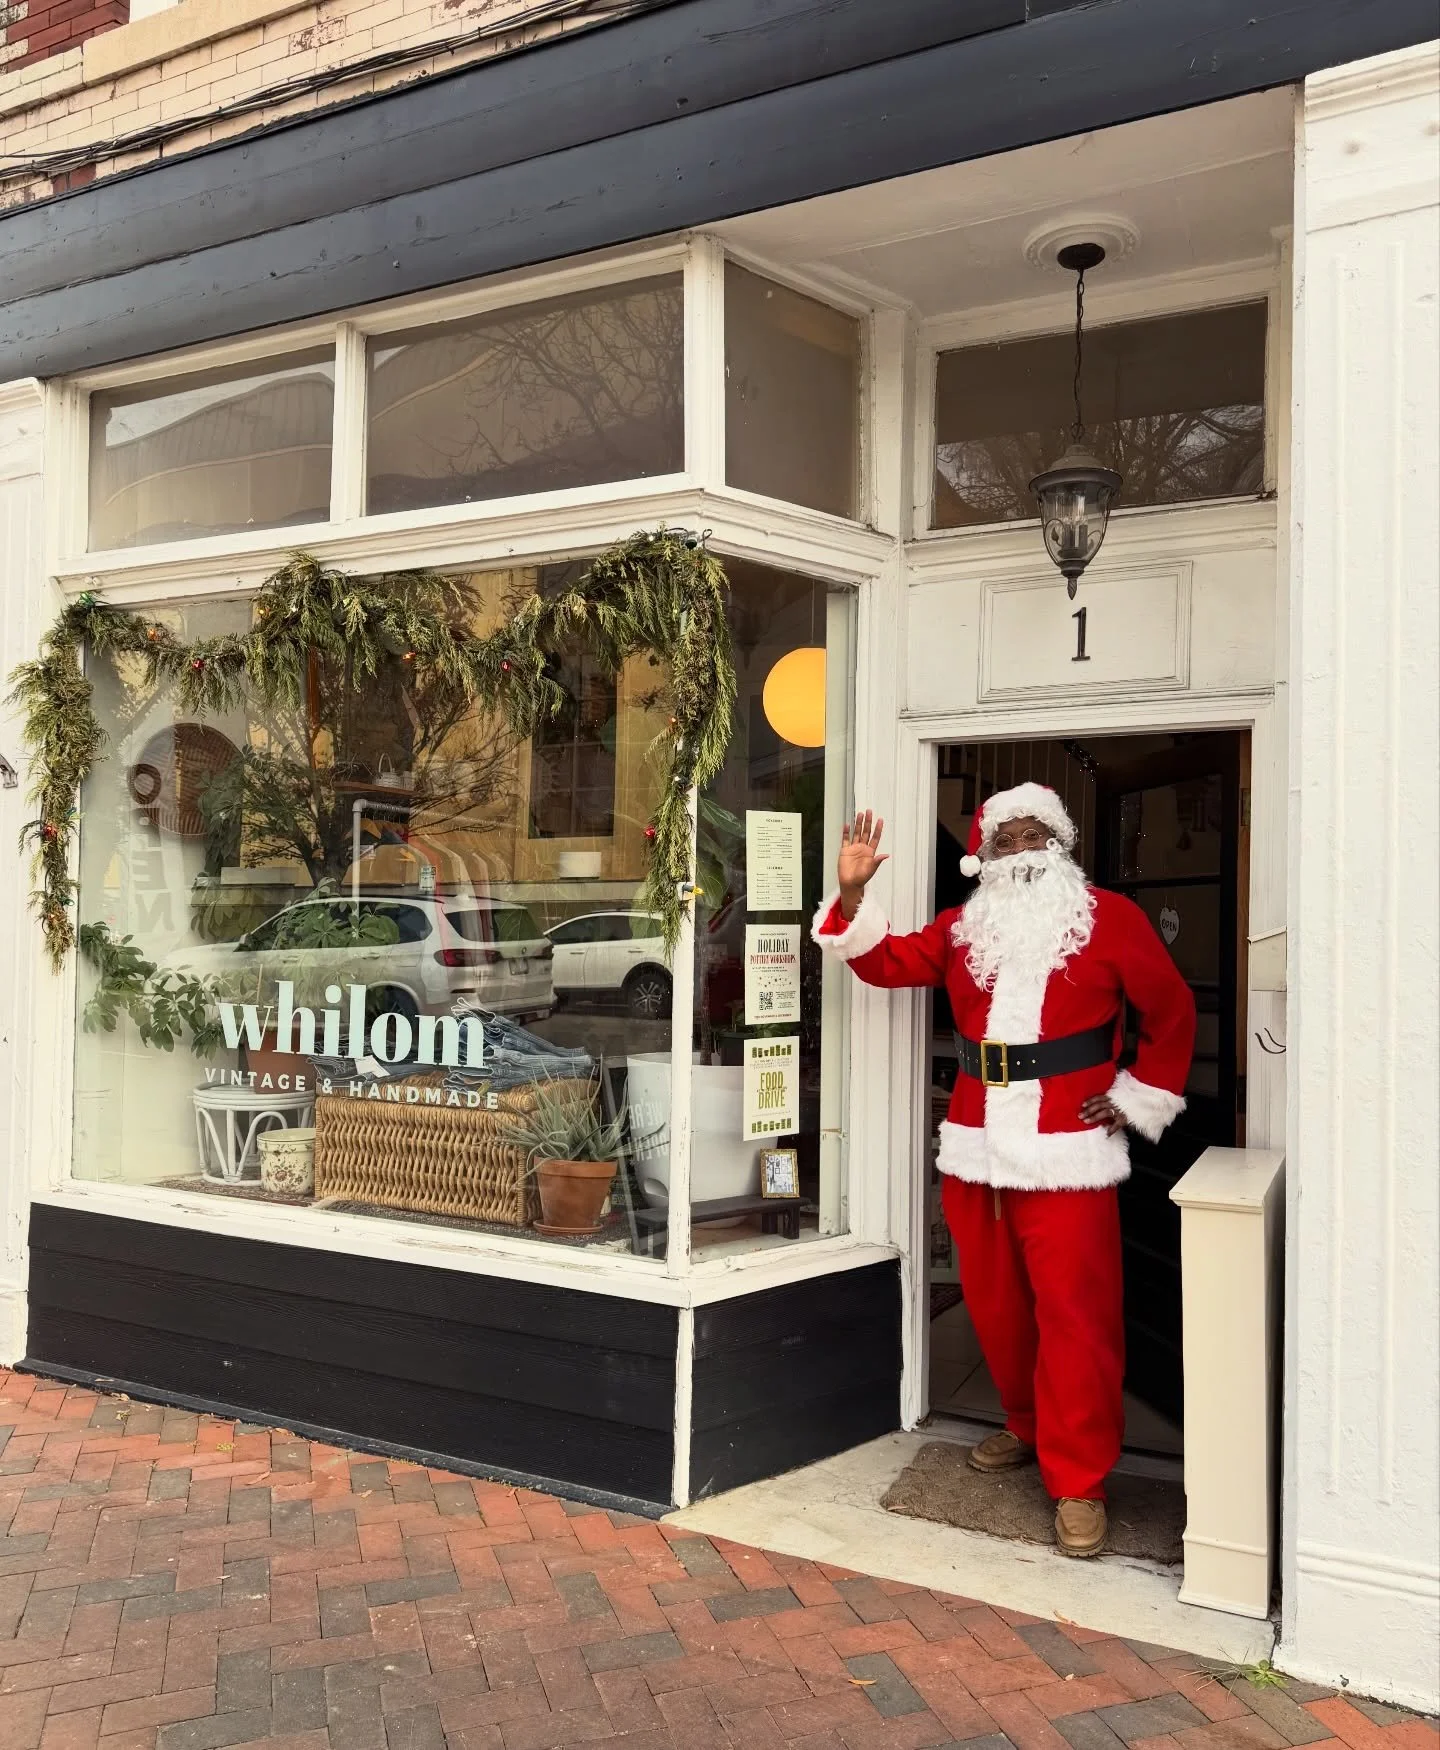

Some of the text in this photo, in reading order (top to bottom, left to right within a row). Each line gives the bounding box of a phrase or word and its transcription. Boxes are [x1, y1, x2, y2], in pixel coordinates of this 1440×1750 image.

[1072, 606, 1091, 661] 1
[1161, 919, 1177, 932] OPEN
[757, 938, 790, 953] HOLIDAY
[215, 980, 487, 1068] whilom
[204, 1067, 499, 1109] VINTAGE & HANDMADE
[760, 1071, 784, 1091] FOOD
[758, 1090, 785, 1109] DRIVE
